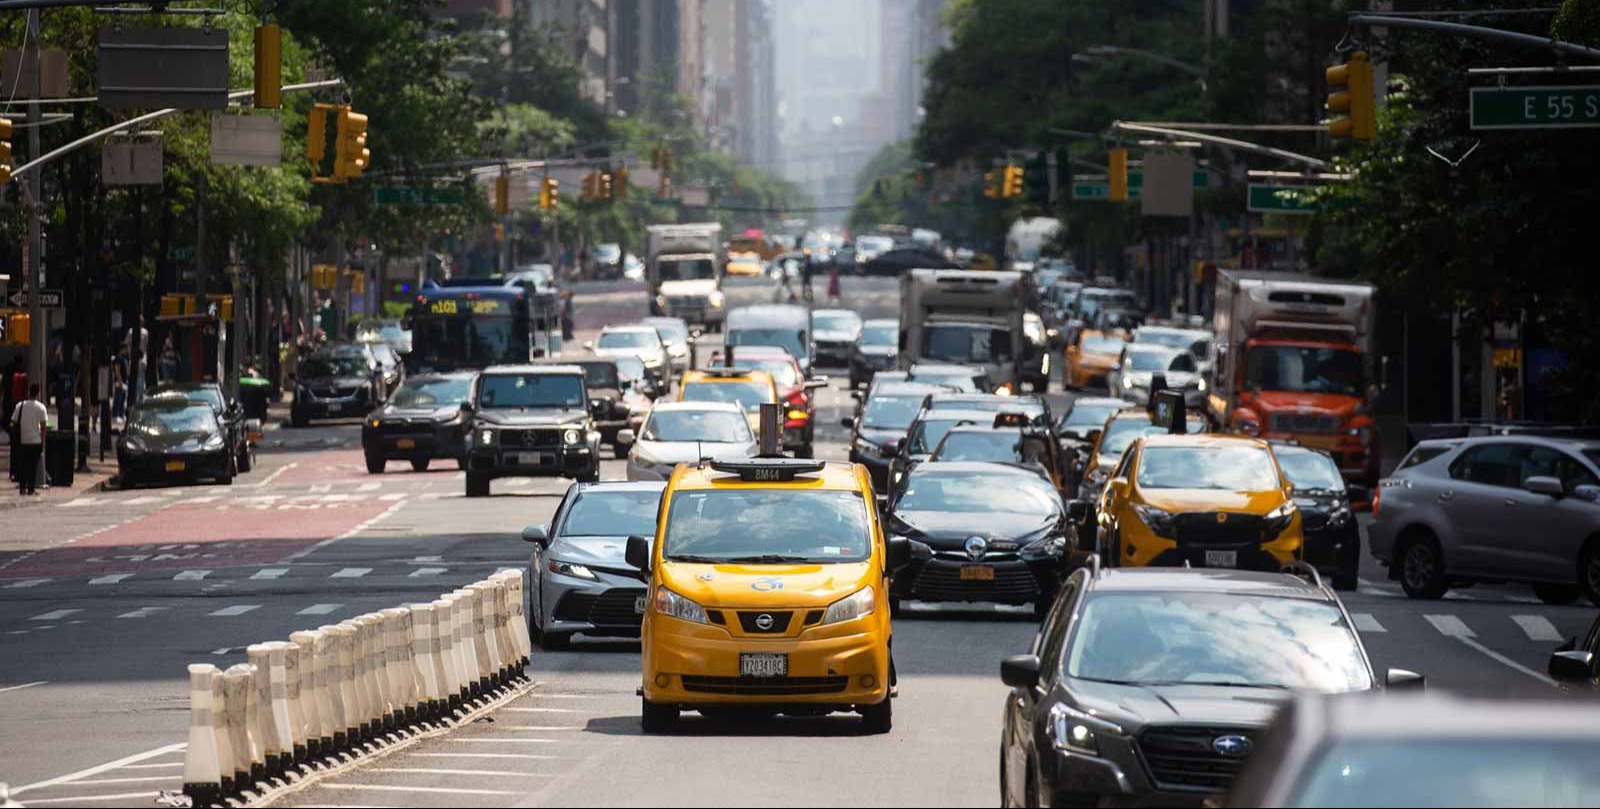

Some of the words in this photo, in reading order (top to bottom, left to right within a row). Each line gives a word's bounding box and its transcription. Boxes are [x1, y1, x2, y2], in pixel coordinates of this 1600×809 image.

[1524, 95, 1537, 119] E
[1547, 95, 1574, 119] 55
[755, 468, 779, 480] 8M44
